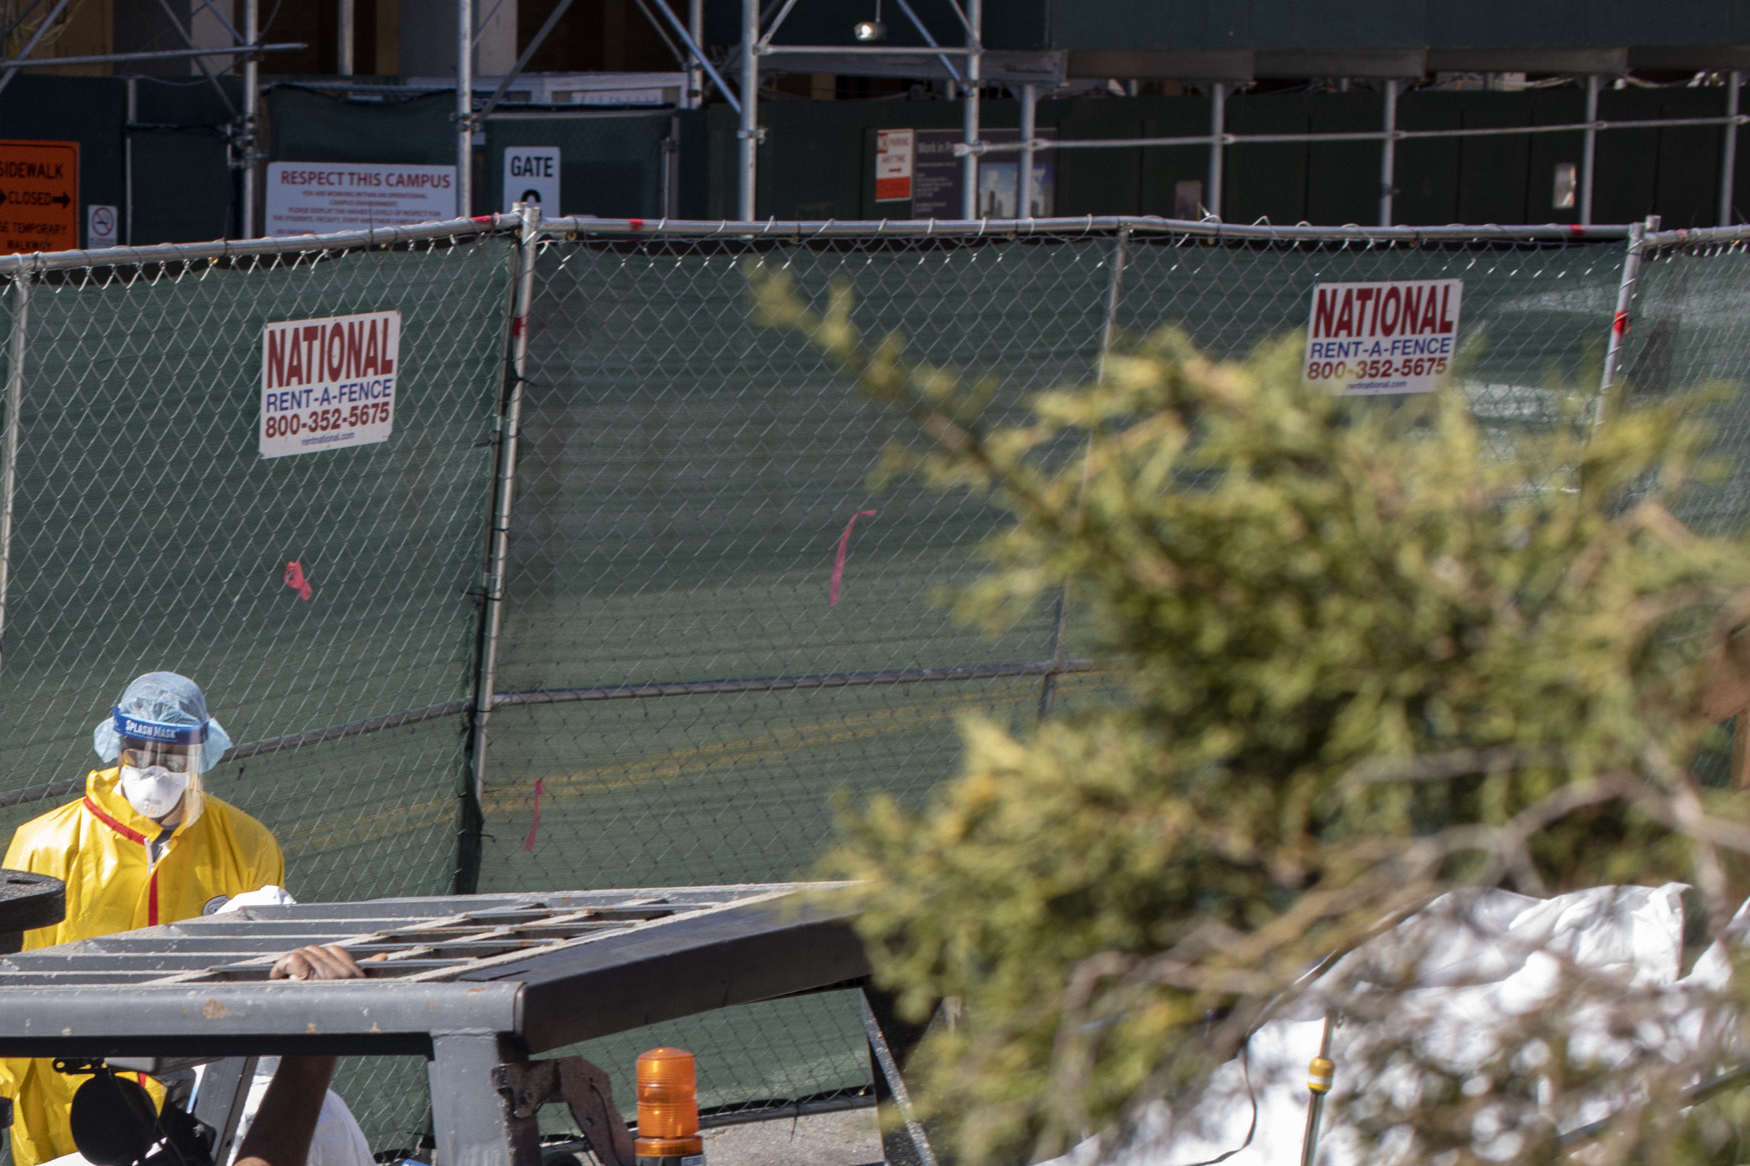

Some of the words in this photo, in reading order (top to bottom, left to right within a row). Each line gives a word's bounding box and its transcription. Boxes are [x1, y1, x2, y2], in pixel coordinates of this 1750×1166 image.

[511, 156, 553, 177] GATE
[281, 171, 345, 186] RESPECT
[348, 172, 382, 187] THIS
[385, 173, 451, 189] CAMPUS
[8, 191, 51, 206] CLOSED
[1313, 284, 1454, 339] NATIONAL
[267, 318, 393, 389] NATIONAL
[1310, 337, 1453, 359] RENT-A-FENCE
[1307, 357, 1448, 380] 800-352-5675
[266, 378, 393, 413] RENT-A-FENCE
[265, 401, 390, 438] 800-352-5675
[125, 719, 153, 736] SPLASH
[154, 726, 178, 739] MASK
